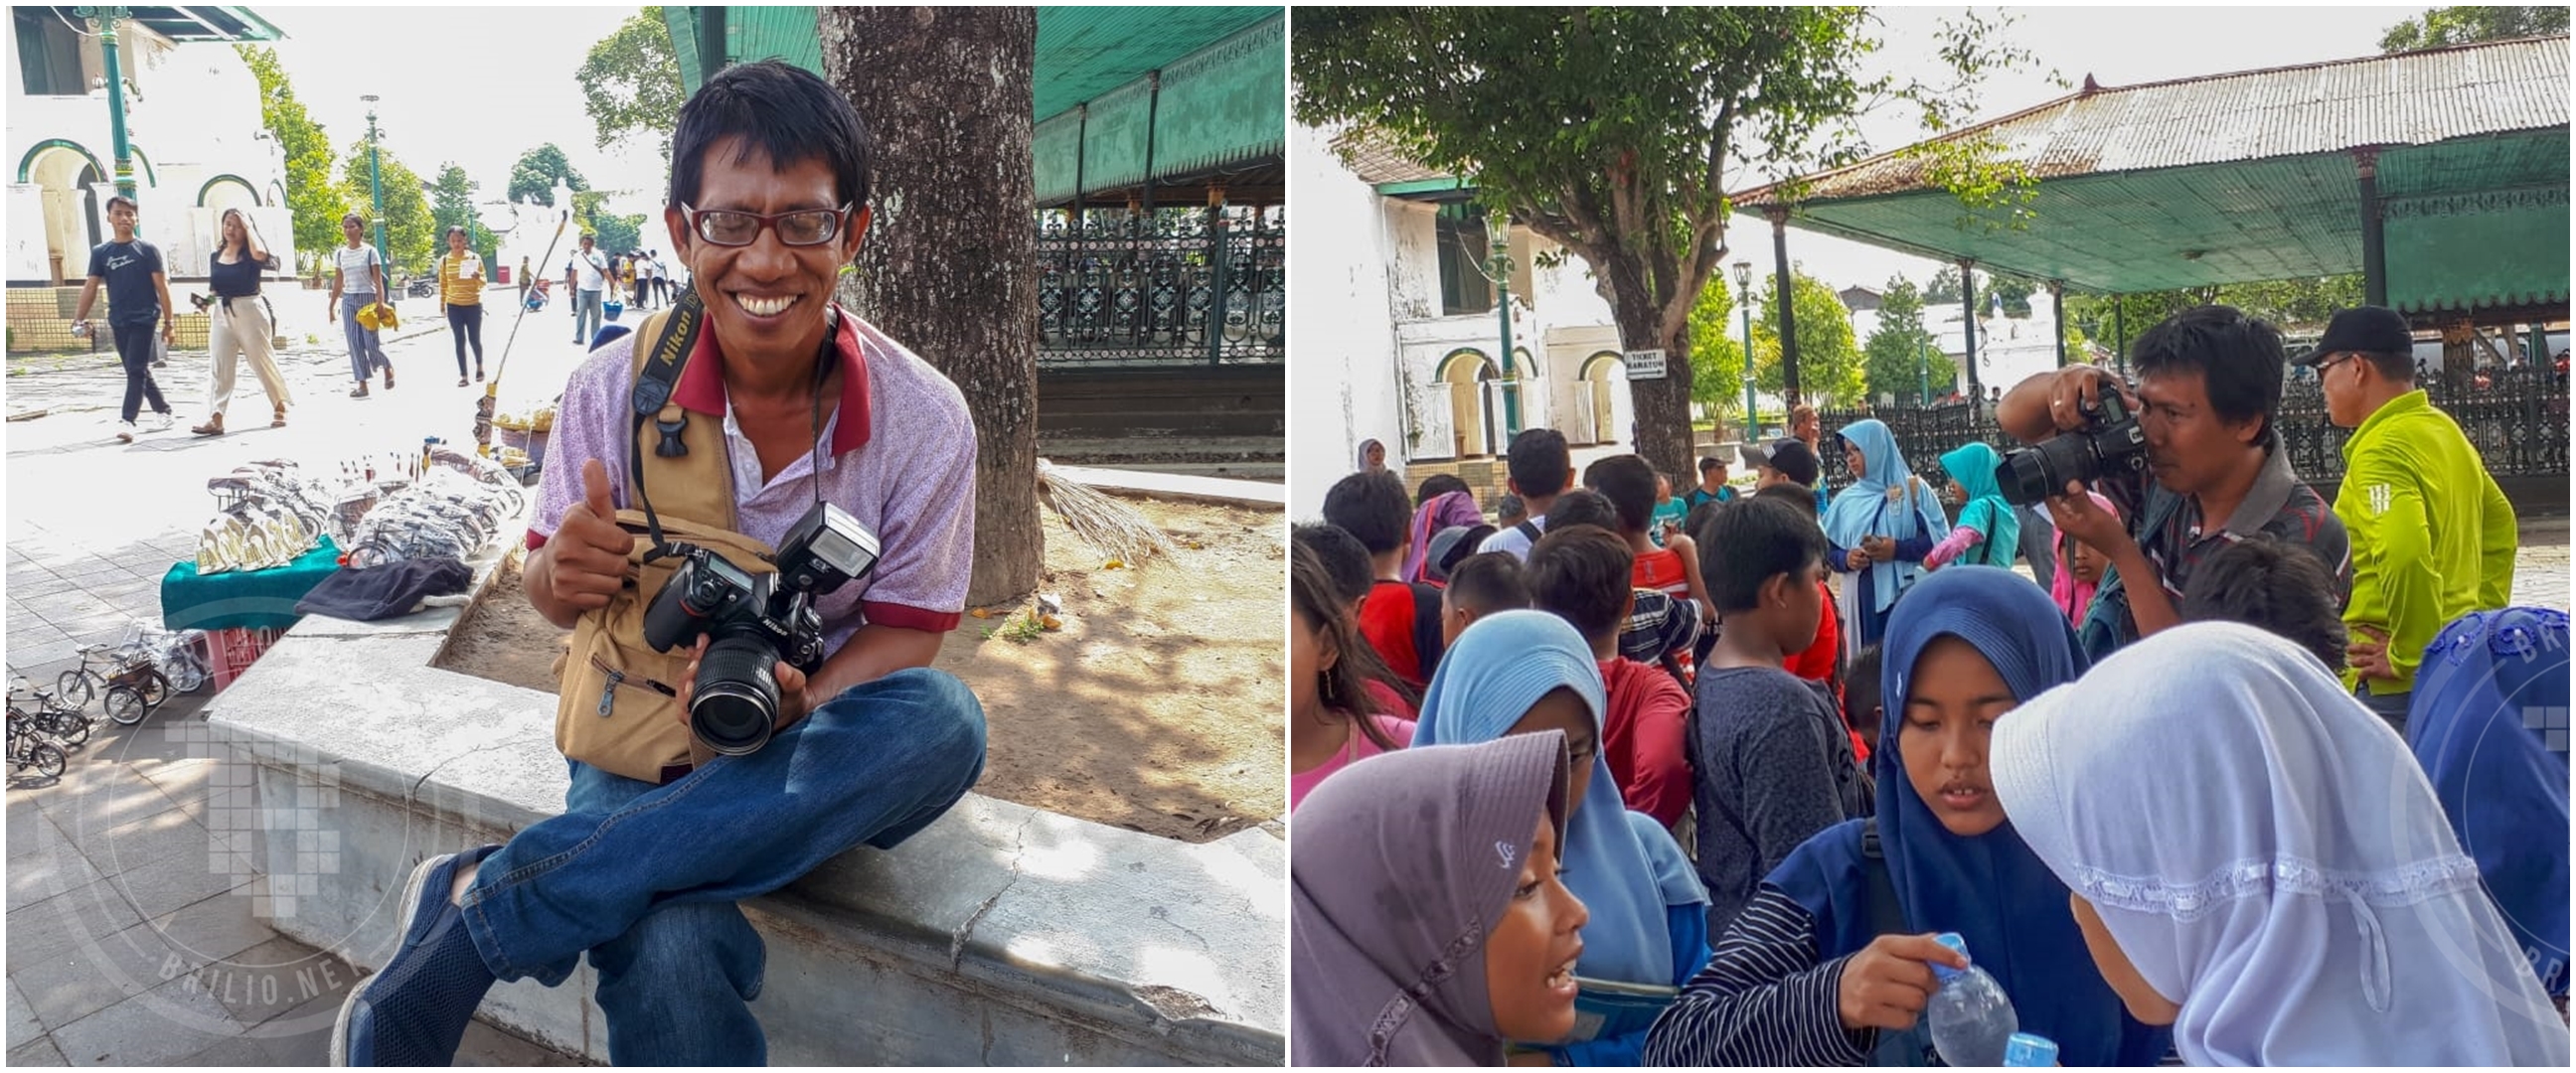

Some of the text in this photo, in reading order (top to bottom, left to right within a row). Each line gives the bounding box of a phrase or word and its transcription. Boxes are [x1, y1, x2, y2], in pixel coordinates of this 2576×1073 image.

[660, 311, 692, 367] Nikon
[1632, 352, 1658, 362] TICKET
[762, 618, 788, 637] Nikon
